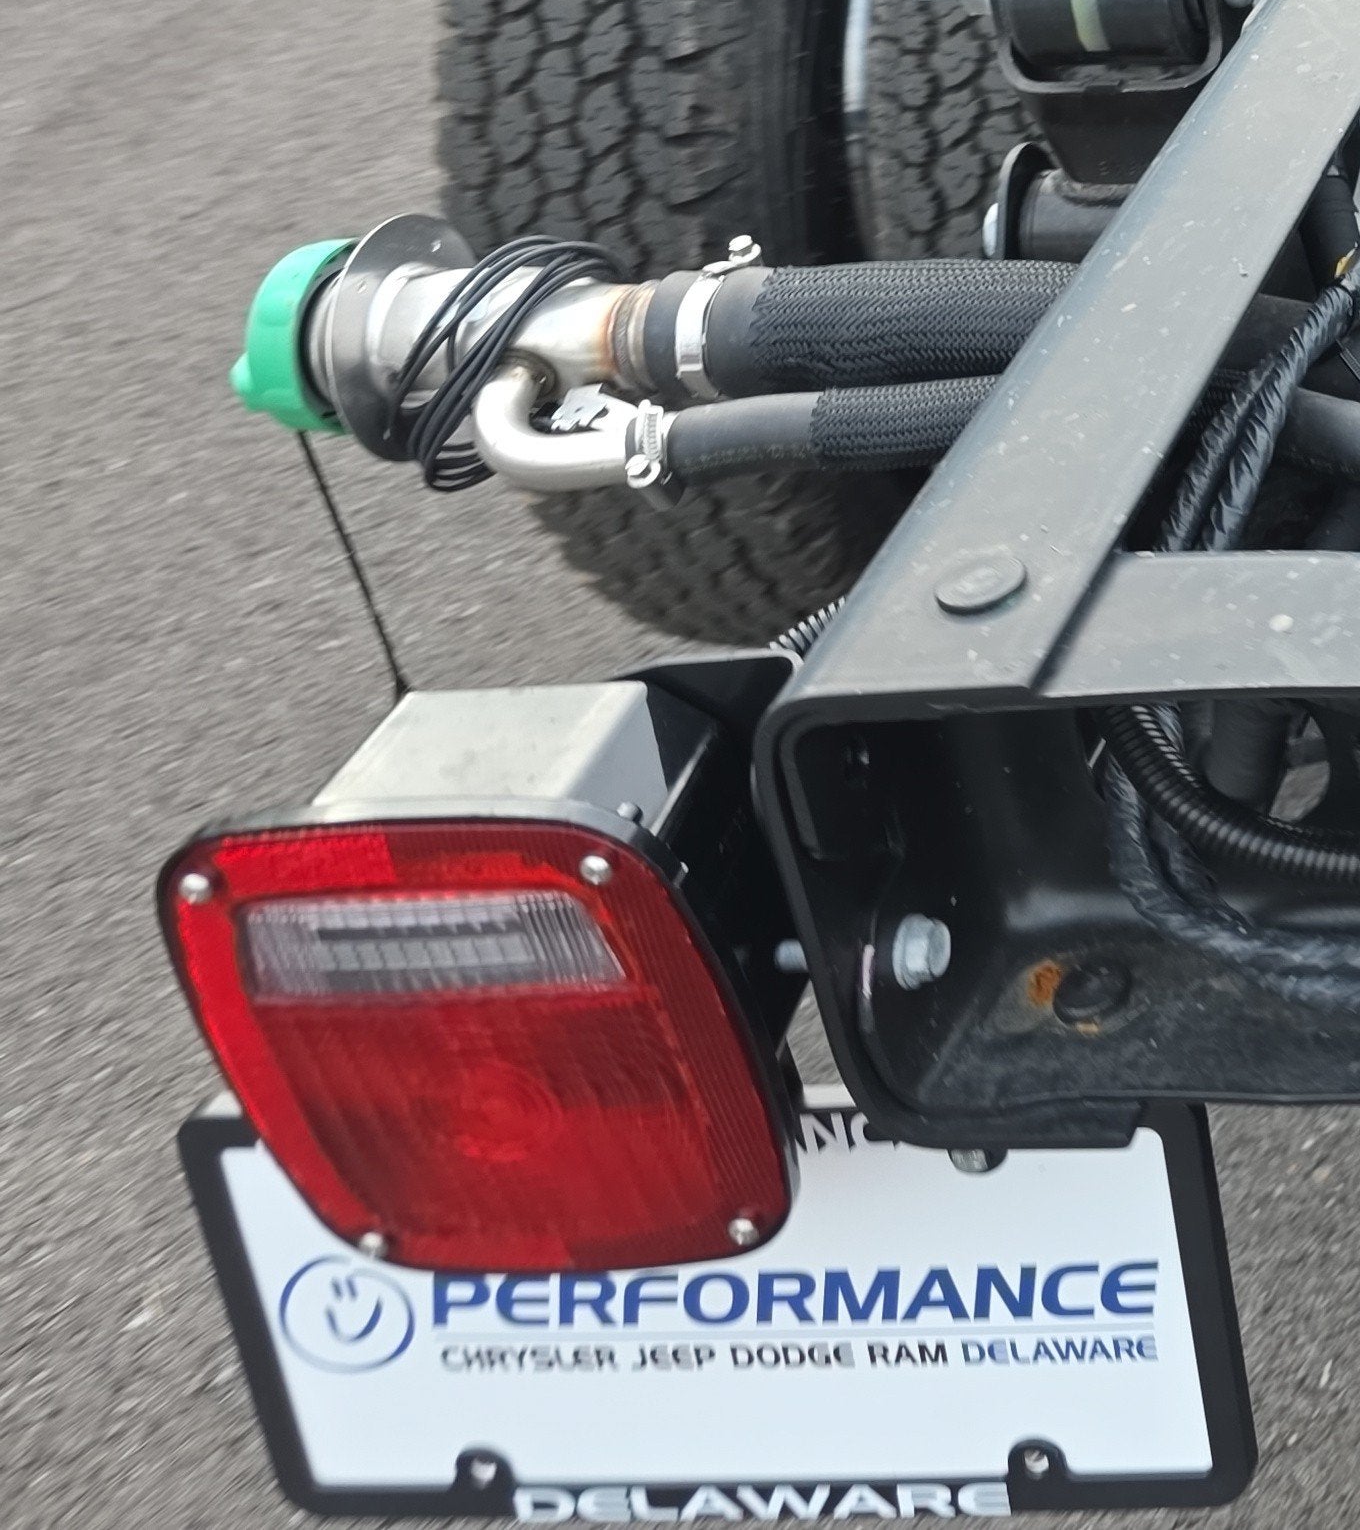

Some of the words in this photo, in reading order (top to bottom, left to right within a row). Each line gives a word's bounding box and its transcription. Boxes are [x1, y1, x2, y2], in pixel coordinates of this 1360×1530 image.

[433, 1261, 1160, 1328] PERFORMANCE
[441, 1343, 617, 1371] CHRYSLER
[631, 1343, 716, 1370] JEEP
[730, 1340, 856, 1369] DODGE
[866, 1338, 949, 1367] RAM
[960, 1334, 1159, 1366] DELAWARE
[513, 1481, 1011, 1523] DELAWARE
